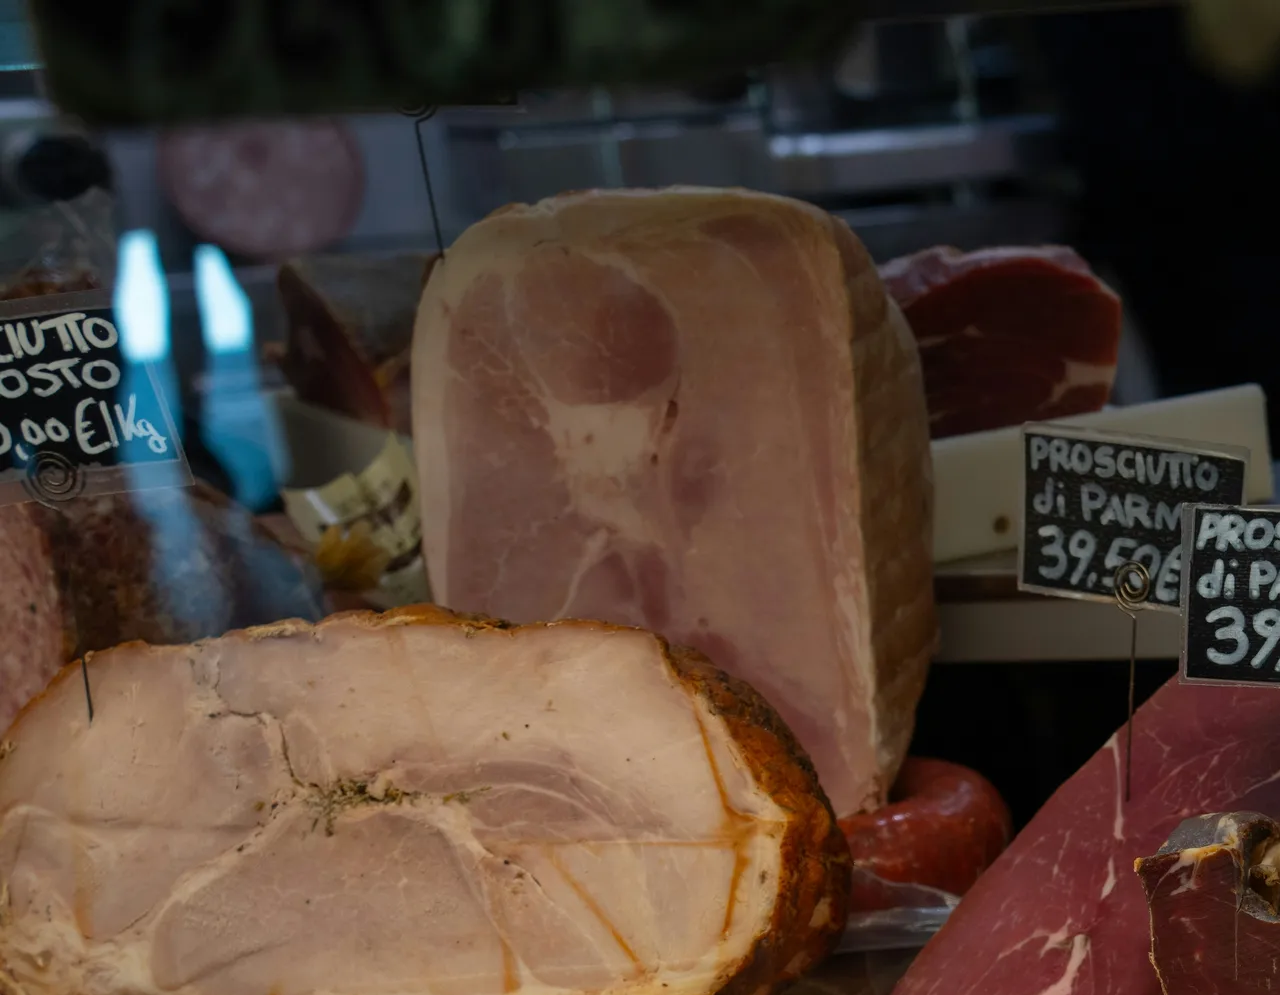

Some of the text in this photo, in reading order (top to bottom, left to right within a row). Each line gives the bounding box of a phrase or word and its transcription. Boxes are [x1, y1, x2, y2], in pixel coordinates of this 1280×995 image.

[1030, 437, 1219, 491] PROSCIUTTO
[1033, 477, 1066, 517] di
[1196, 558, 1239, 599] di
